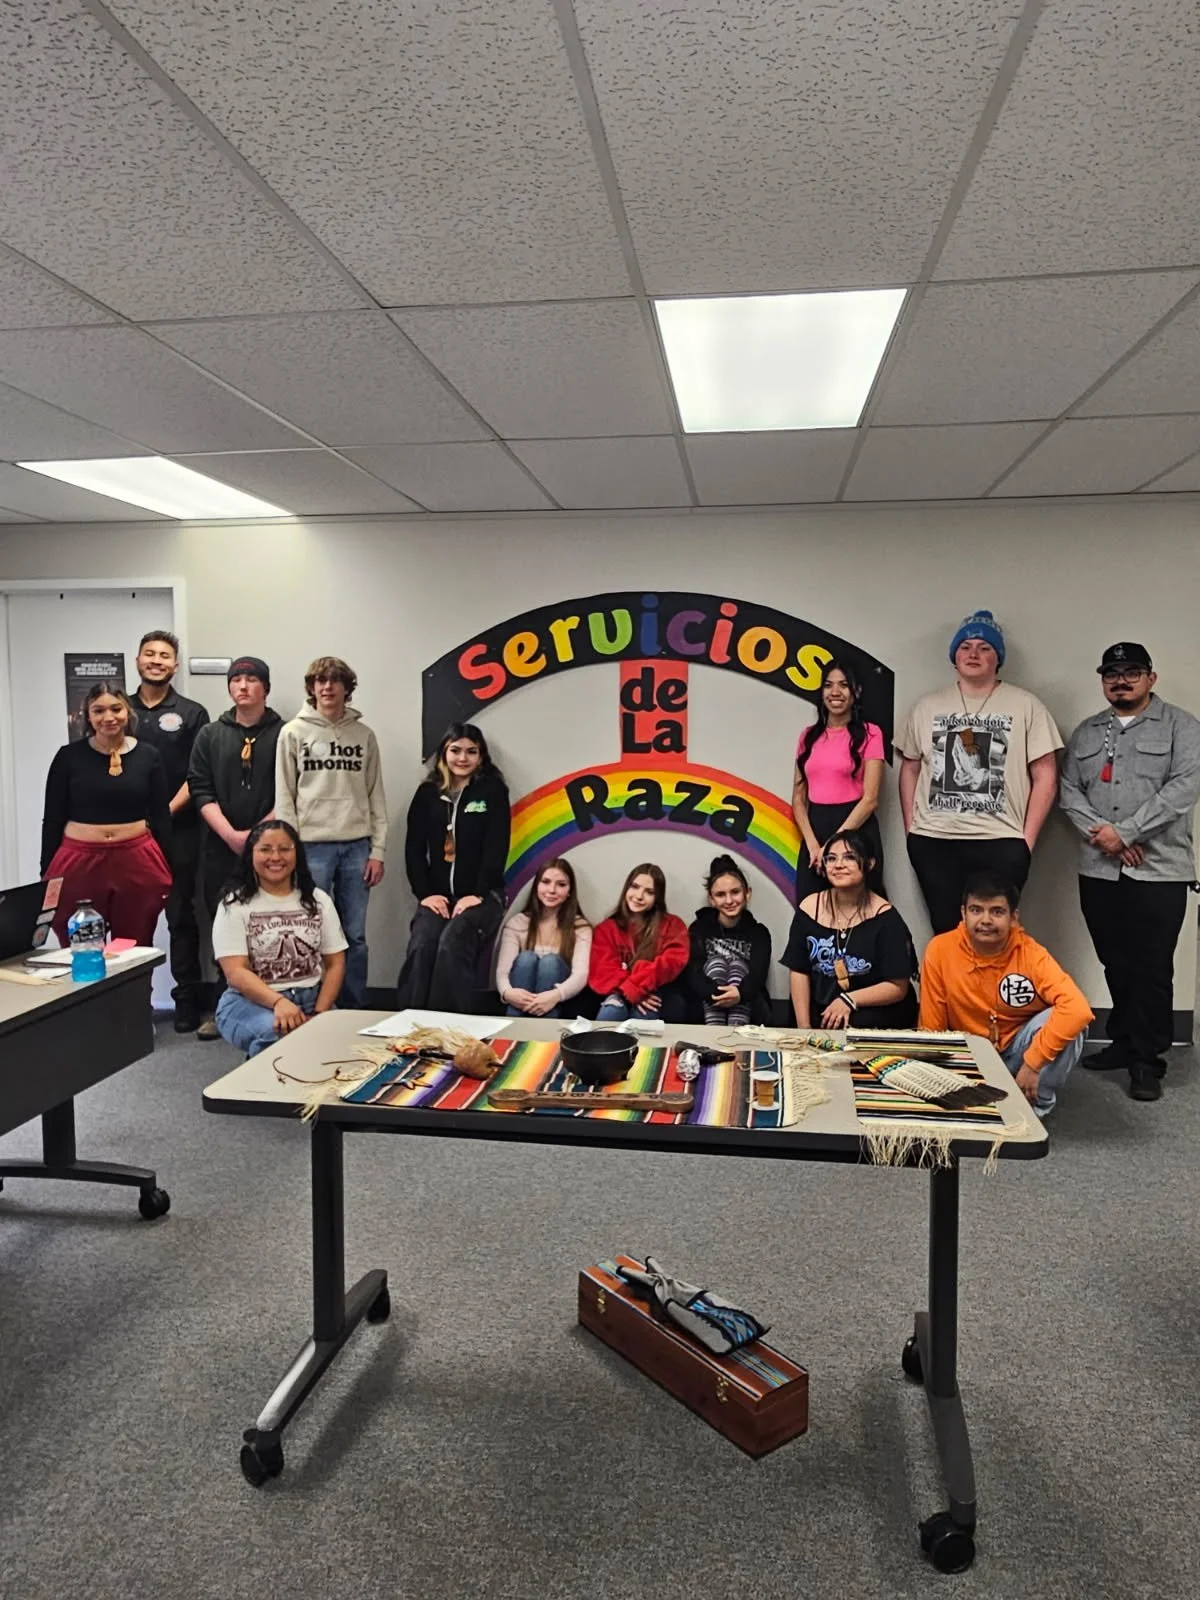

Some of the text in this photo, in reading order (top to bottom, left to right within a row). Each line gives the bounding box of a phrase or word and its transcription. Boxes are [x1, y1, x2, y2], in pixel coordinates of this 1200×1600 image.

[458, 594, 834, 700] Servicios
[620, 666, 688, 713] de
[303, 742, 363, 758] i hot
[621, 712, 687, 754] La
[303, 759, 362, 772] moms
[565, 774, 755, 843] Raza
